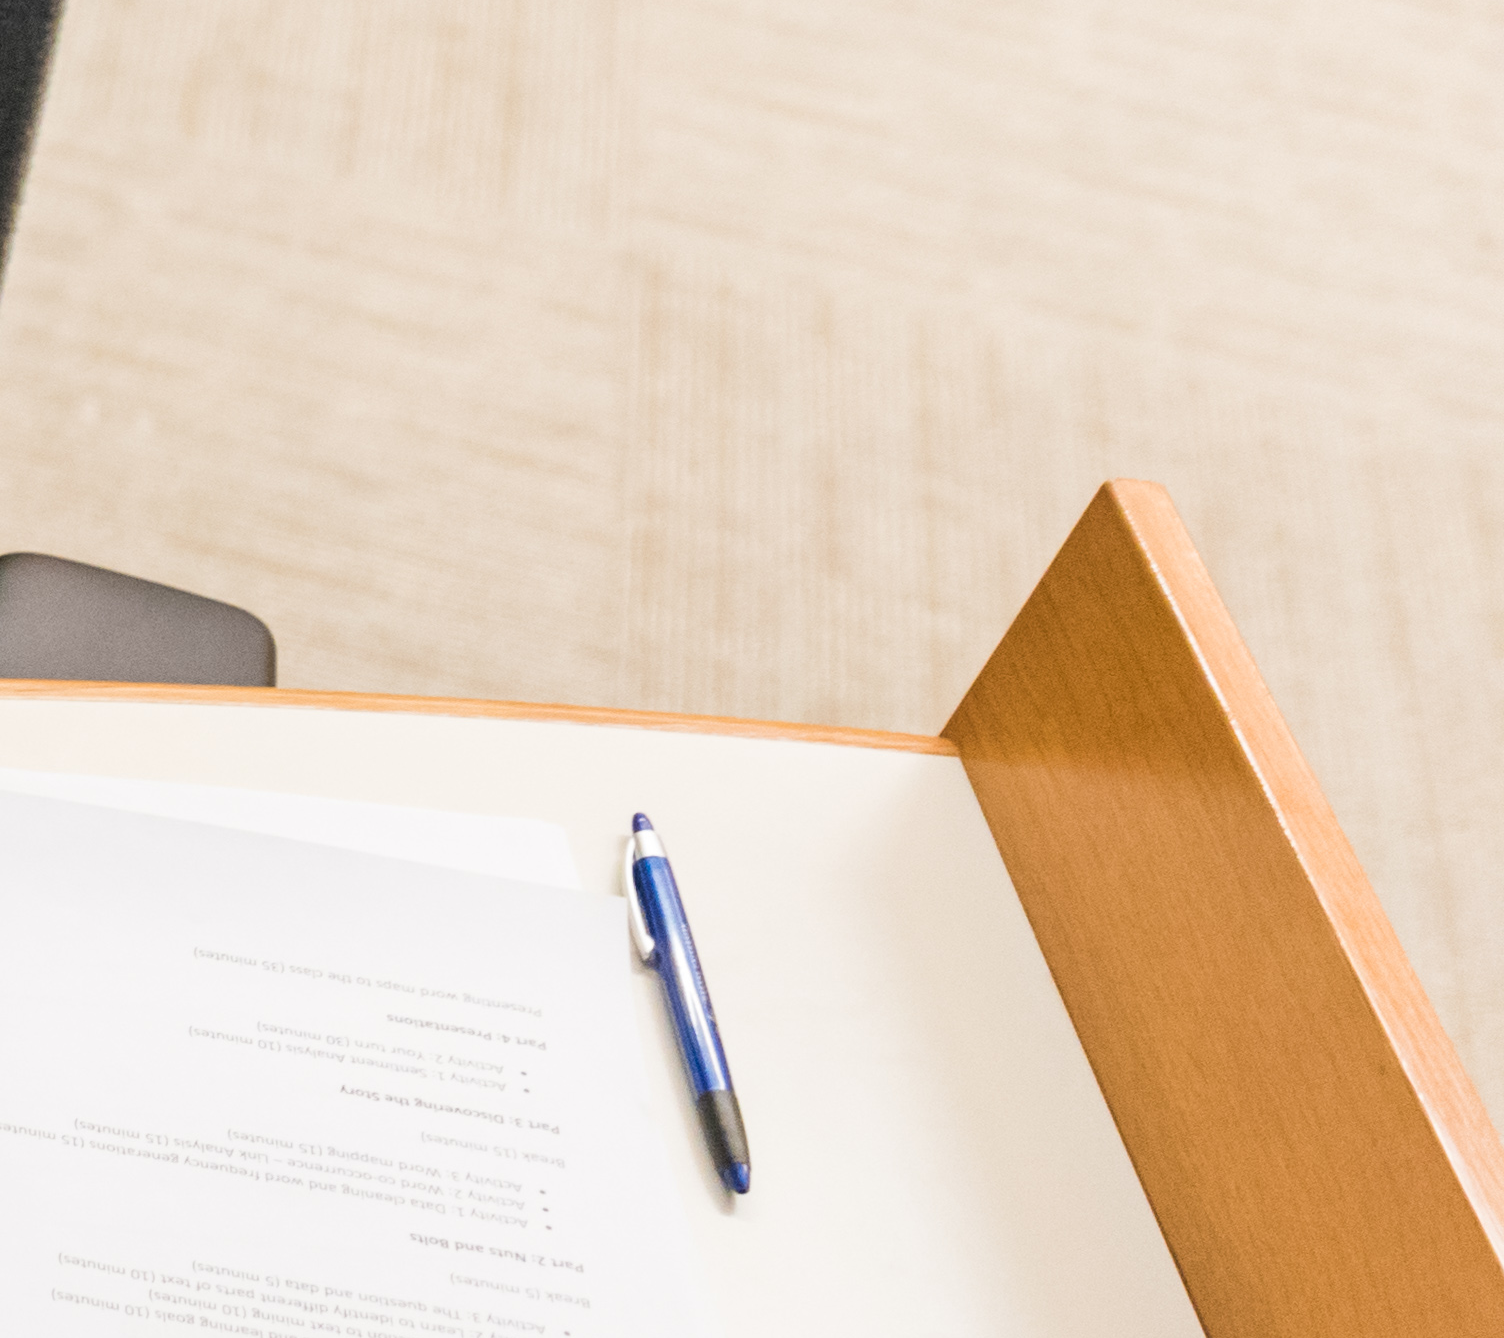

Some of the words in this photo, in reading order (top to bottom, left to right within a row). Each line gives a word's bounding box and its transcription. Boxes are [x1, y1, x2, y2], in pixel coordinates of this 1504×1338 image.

[385, 1013, 492, 1041] Presentations
[515, 1036, 547, 1051] Part
[339, 1083, 380, 1102] Story
[384, 1093, 410, 1106] the
[413, 1096, 504, 1124] Discovering
[528, 1120, 560, 1135] Part
[409, 1232, 449, 1249] Bolts
[454, 1240, 484, 1253] and
[488, 1246, 526, 1263] Nuts
[550, 1258, 584, 1273] Part
